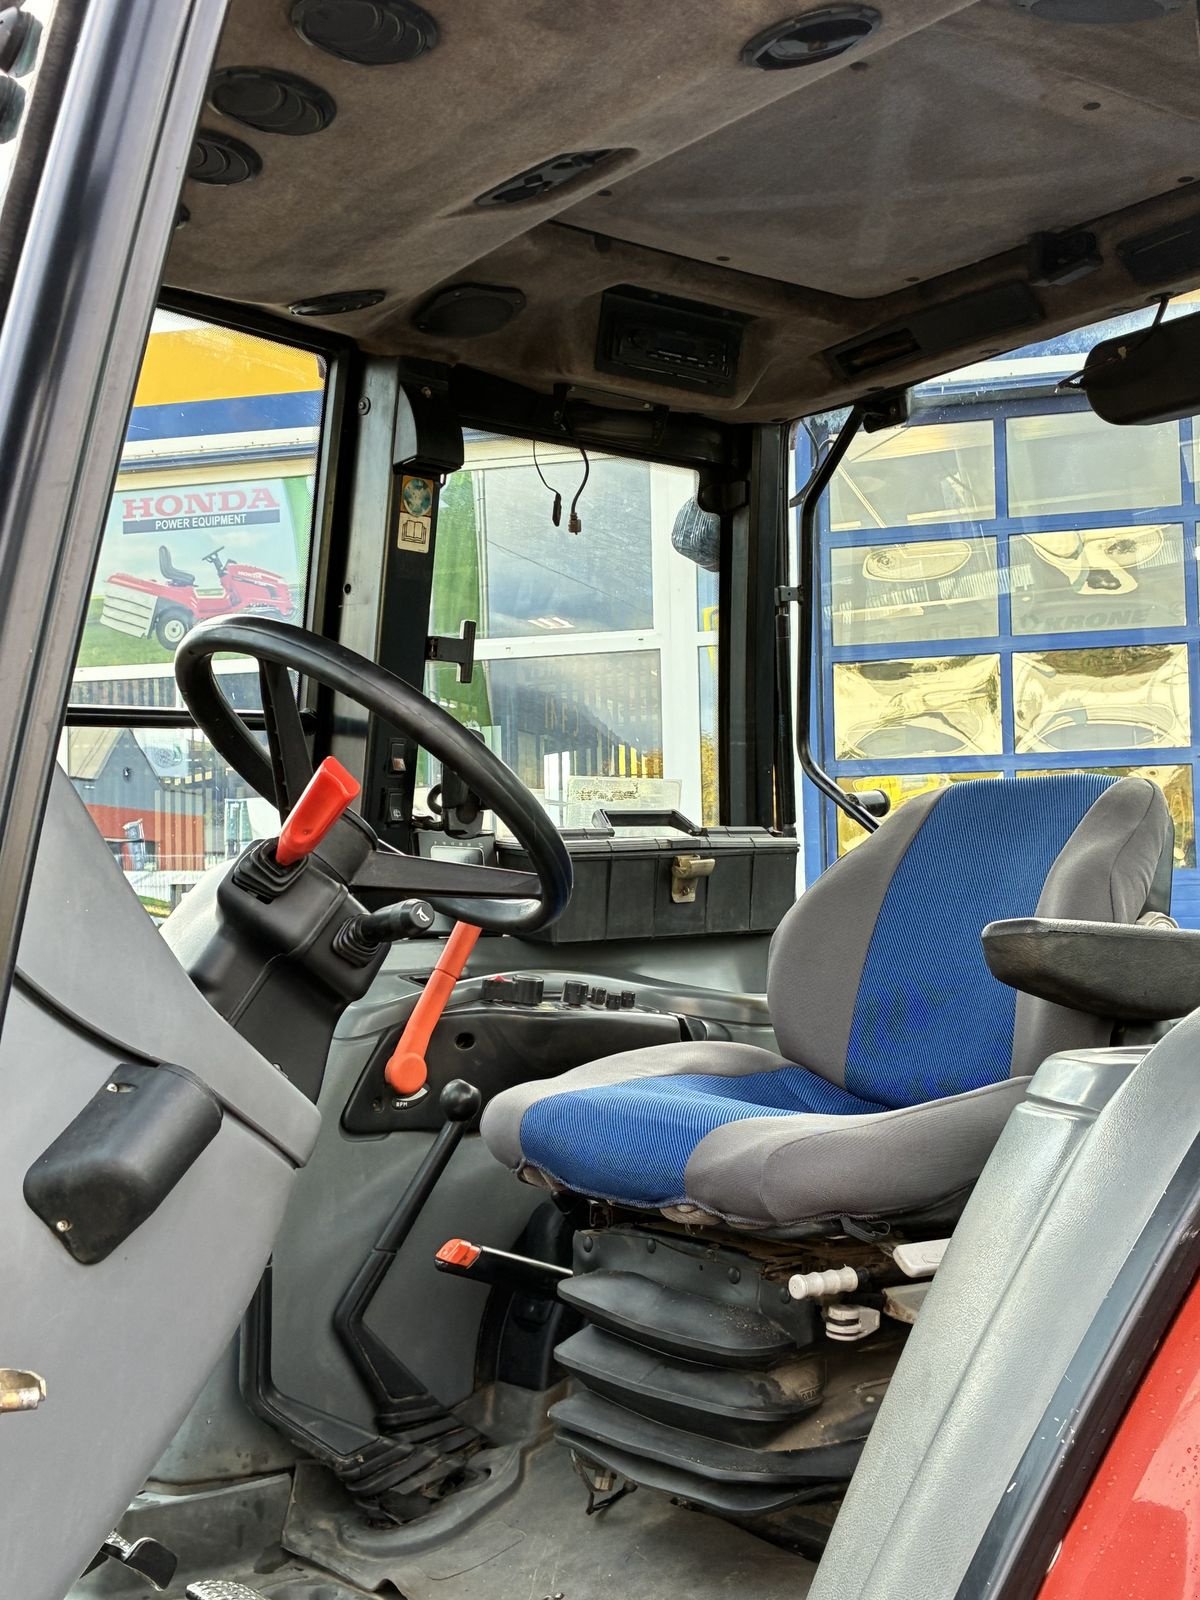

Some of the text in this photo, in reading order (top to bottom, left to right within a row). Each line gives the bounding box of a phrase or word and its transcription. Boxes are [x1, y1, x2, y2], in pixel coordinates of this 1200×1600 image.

[122, 488, 280, 519] HONDA
[155, 513, 247, 530] POWER EQUIPMENT
[1044, 609, 1150, 630] KRONE
